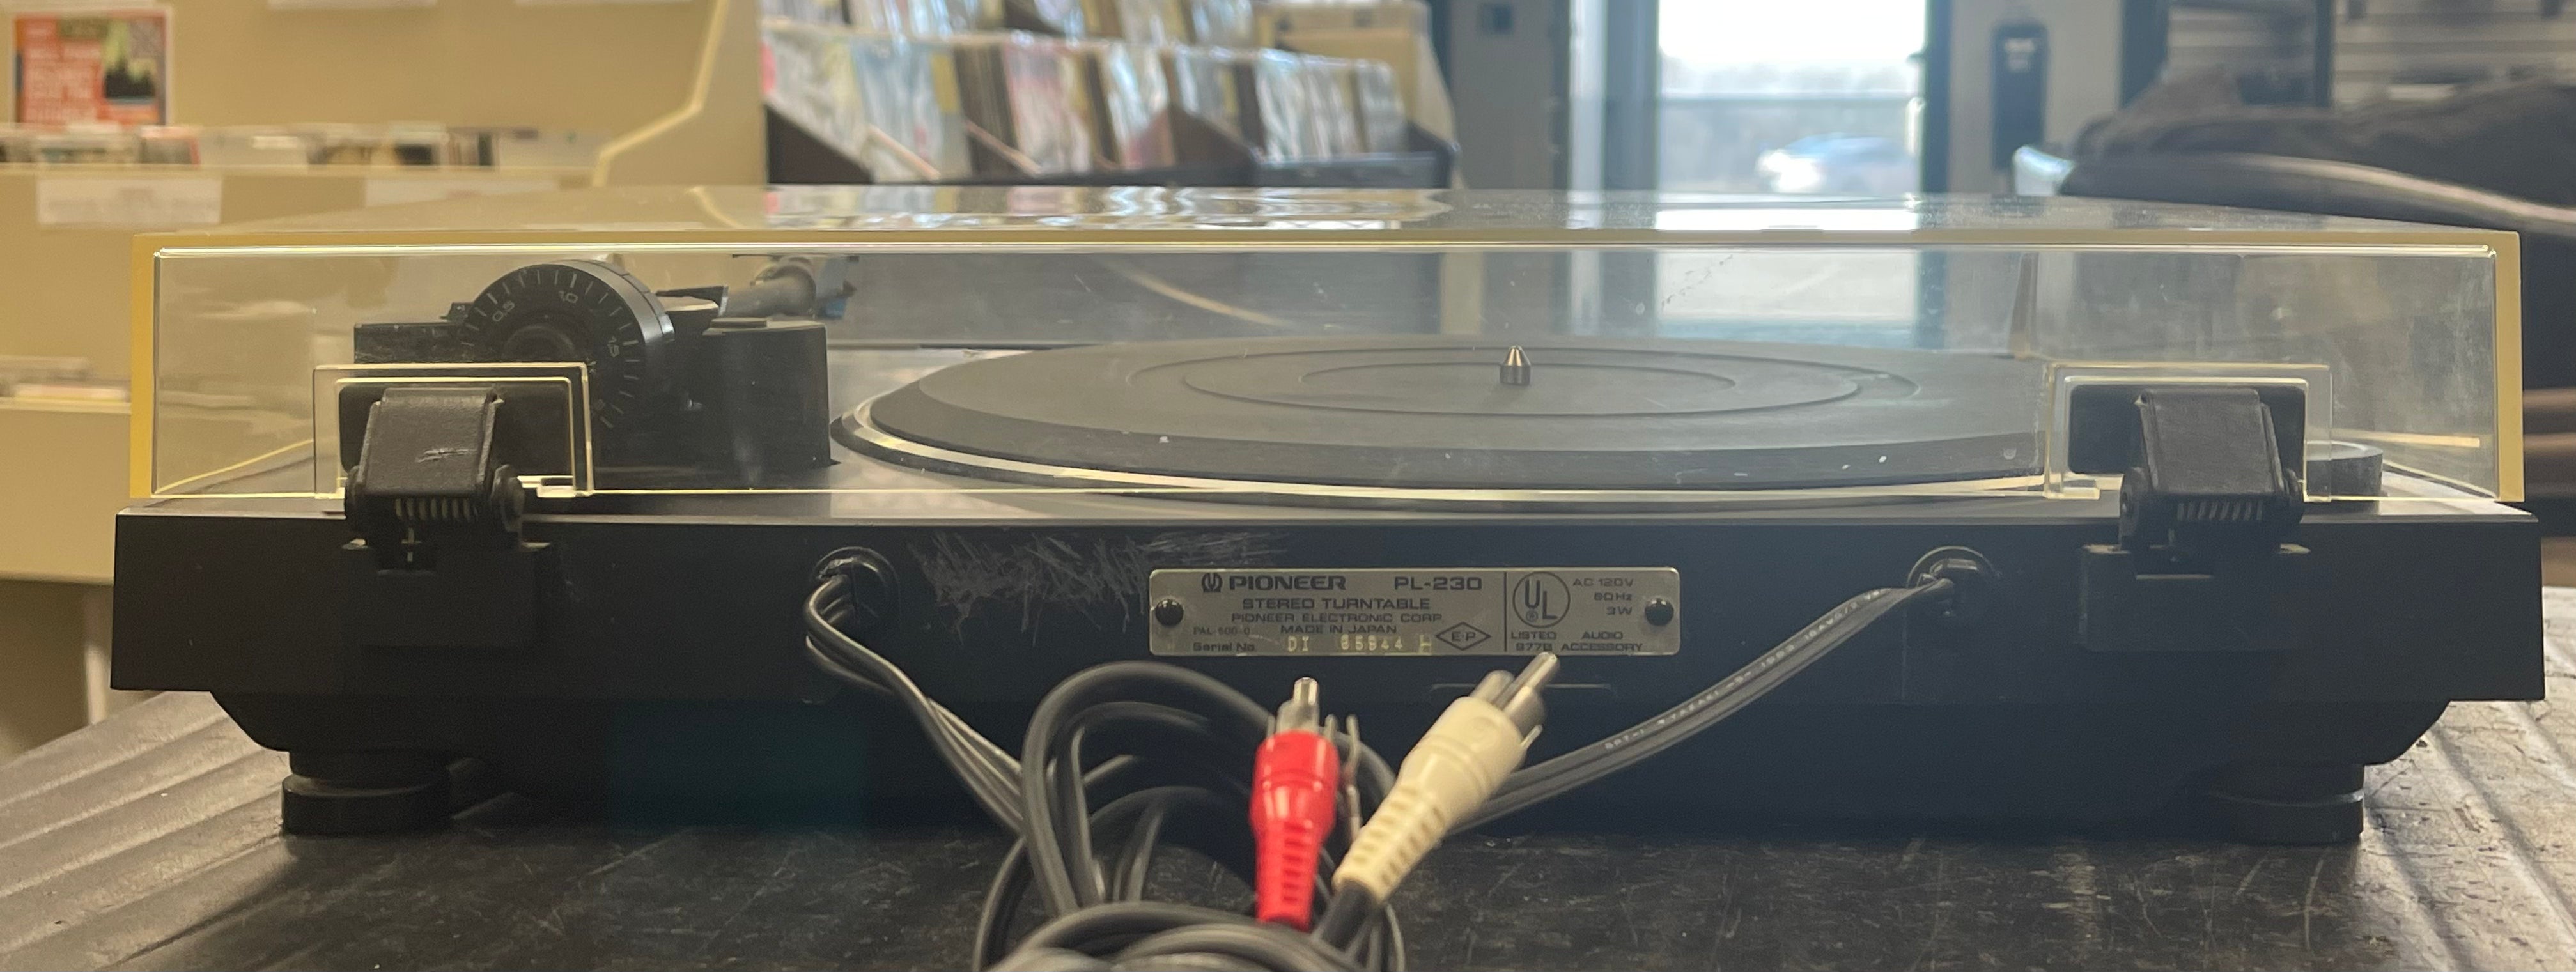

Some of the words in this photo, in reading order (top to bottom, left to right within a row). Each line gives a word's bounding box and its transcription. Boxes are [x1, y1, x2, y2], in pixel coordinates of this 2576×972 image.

[1229, 576, 1346, 590] PIONEER
[1395, 576, 1482, 590] PL-230
[1572, 578, 1594, 587] AC
[1599, 578, 1634, 587] 120V
[1243, 598, 1314, 609] STEREO
[1321, 598, 1430, 609] TURNTABLE
[1232, 613, 1294, 622] PIONEER
[1302, 613, 1392, 622] ELECTRONIC
[1280, 624, 1323, 633] MADE
[1330, 624, 1342, 633] IN
[1348, 624, 1397, 633] JAPAN
[1193, 642, 1232, 651] Serial
[1562, 643, 1643, 651] ACCESSORY
